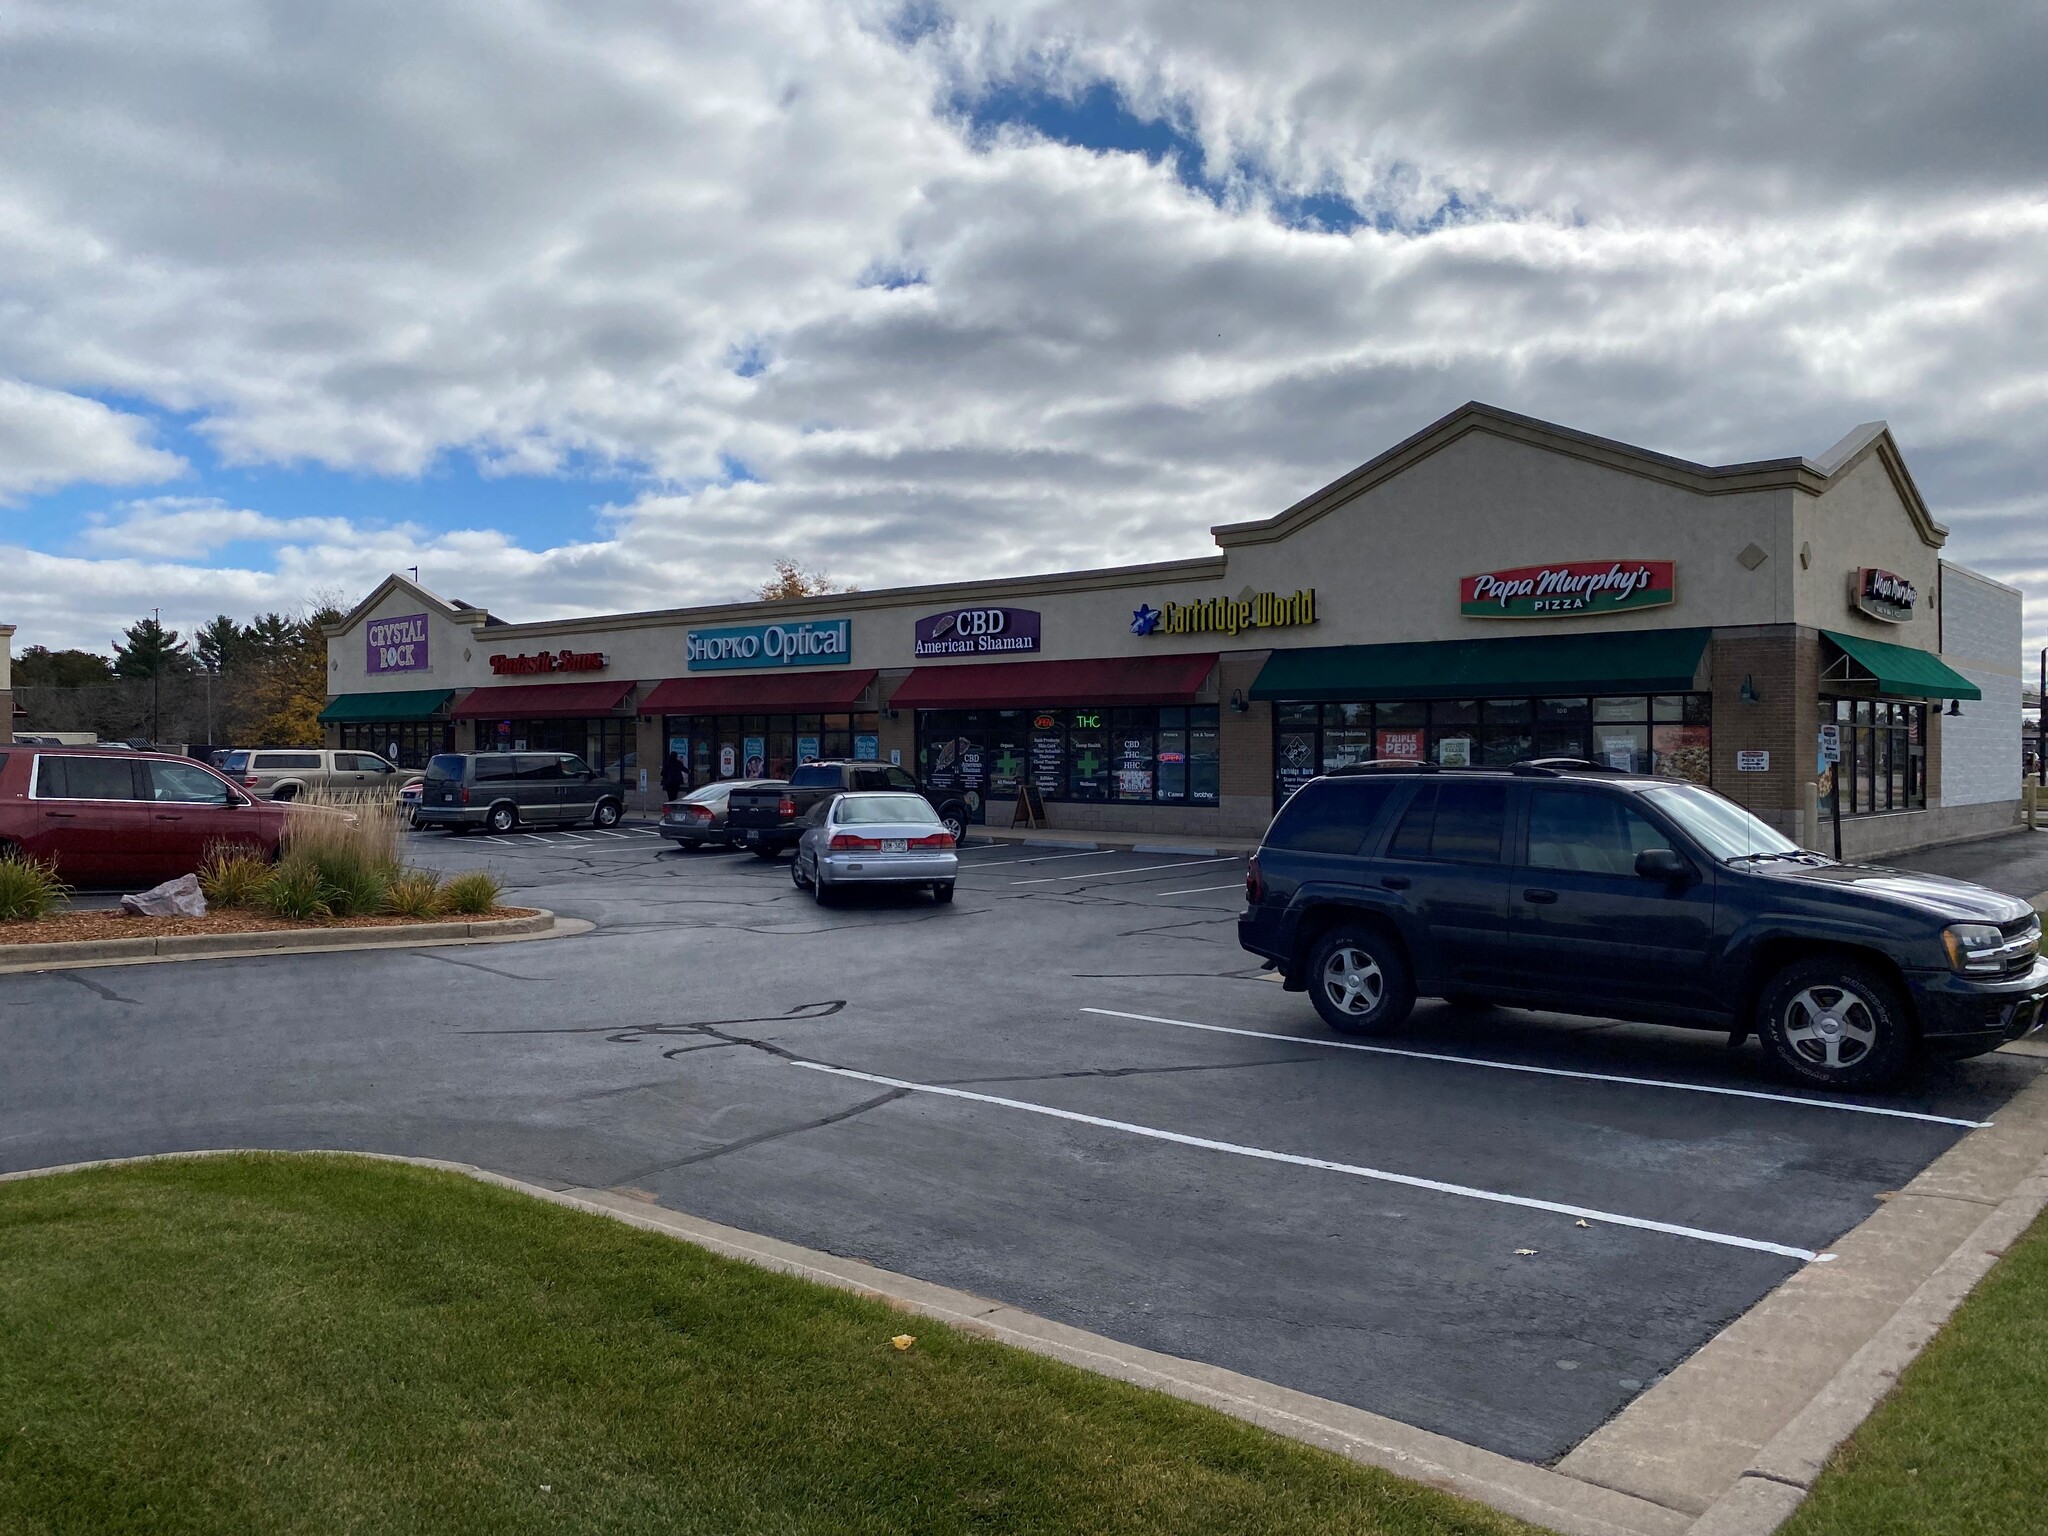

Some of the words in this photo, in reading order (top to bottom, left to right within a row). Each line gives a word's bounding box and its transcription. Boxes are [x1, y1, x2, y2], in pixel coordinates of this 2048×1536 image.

[1474, 575, 1533, 608] Papa
[1537, 564, 1650, 603] Murphy's
[1534, 599, 1583, 611] PIZZA
[1163, 596, 1251, 636] Cartridge
[1257, 588, 1316, 627] World
[956, 610, 1004, 636] CBD
[369, 620, 426, 647] CRYSTAL
[764, 622, 847, 663] Optical
[915, 638, 975, 654] American
[978, 636, 1034, 651] Shaman
[380, 644, 414, 668] ROCK
[490, 651, 557, 675] Fantastic
[1076, 715, 1101, 728] THC
[1124, 740, 1140, 748] CBD
[1385, 734, 1417, 743] TRIPLE
[1123, 751, 1140, 759] THC
[1385, 743, 1418, 754] PEPP
[964, 754, 980, 763] CBD
[1123, 761, 1141, 769] HHC
[1281, 767, 1300, 776] Cartridge
